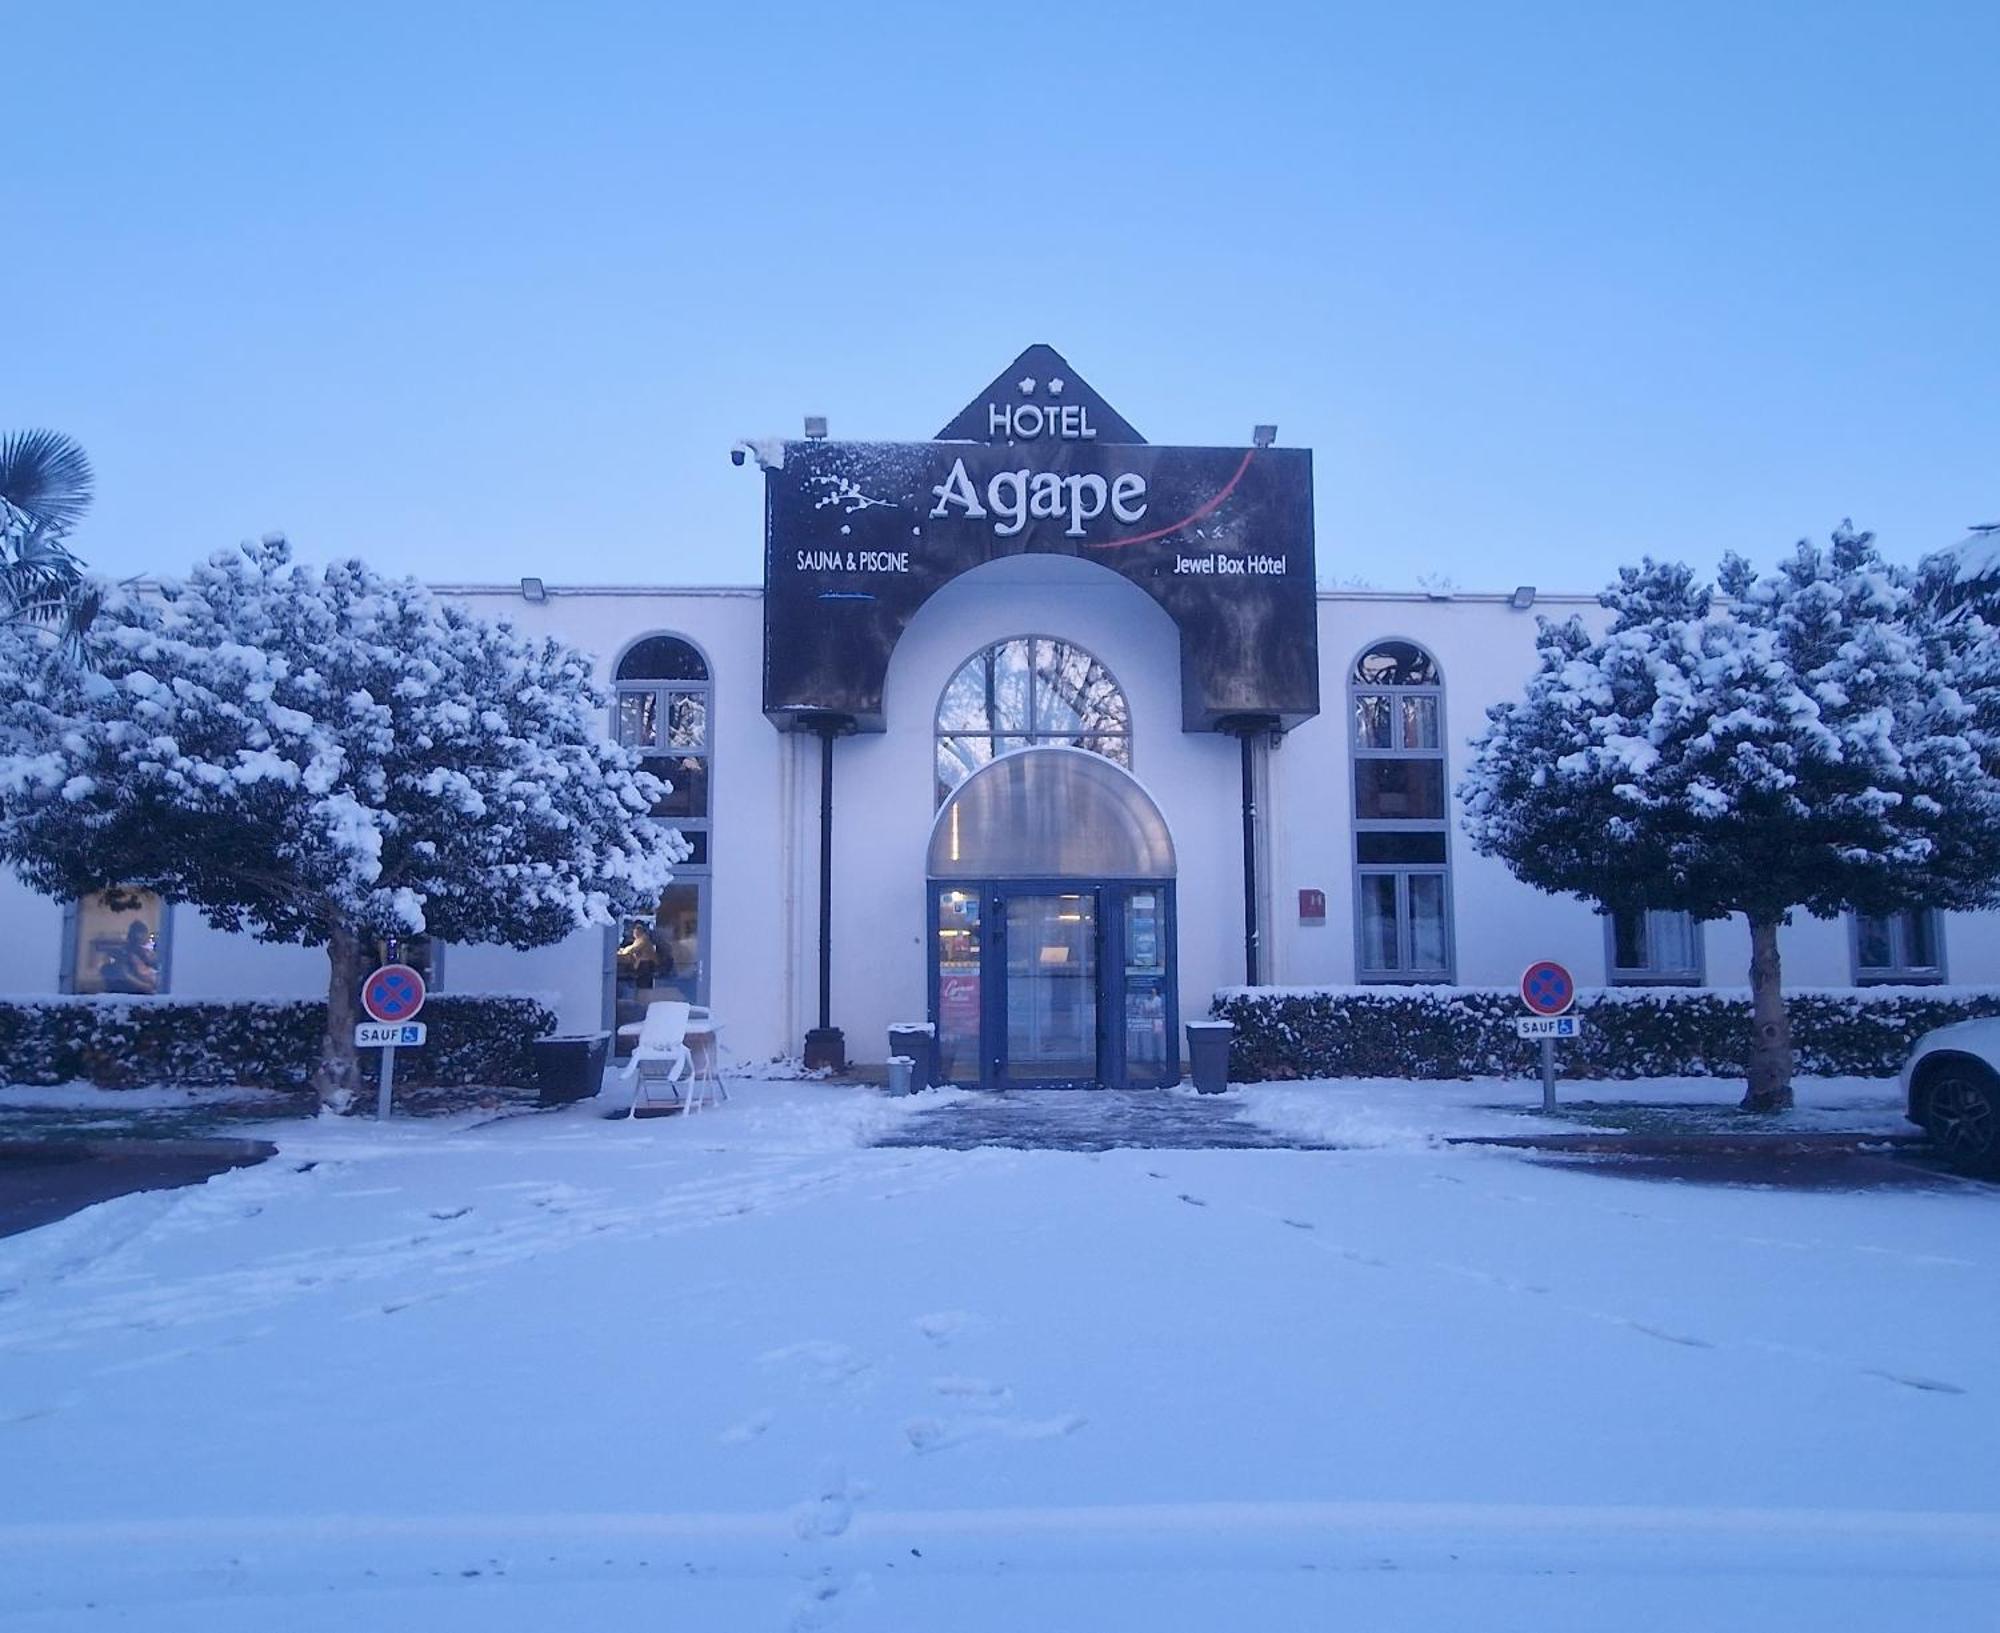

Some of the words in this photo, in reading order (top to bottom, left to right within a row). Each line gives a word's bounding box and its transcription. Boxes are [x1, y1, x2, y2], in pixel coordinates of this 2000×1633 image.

[989, 403, 1097, 438] HOTEL
[929, 457, 1148, 536] Agape
[796, 549, 843, 571] SAUNA
[846, 551, 857, 571] &
[859, 551, 909, 572] PISCINE
[1173, 553, 1215, 574] Jewel
[1217, 554, 1245, 574] Box
[1247, 554, 1287, 575] Hôtel
[361, 1029, 399, 1041] SAUF
[1522, 1021, 1556, 1033] SAUF
